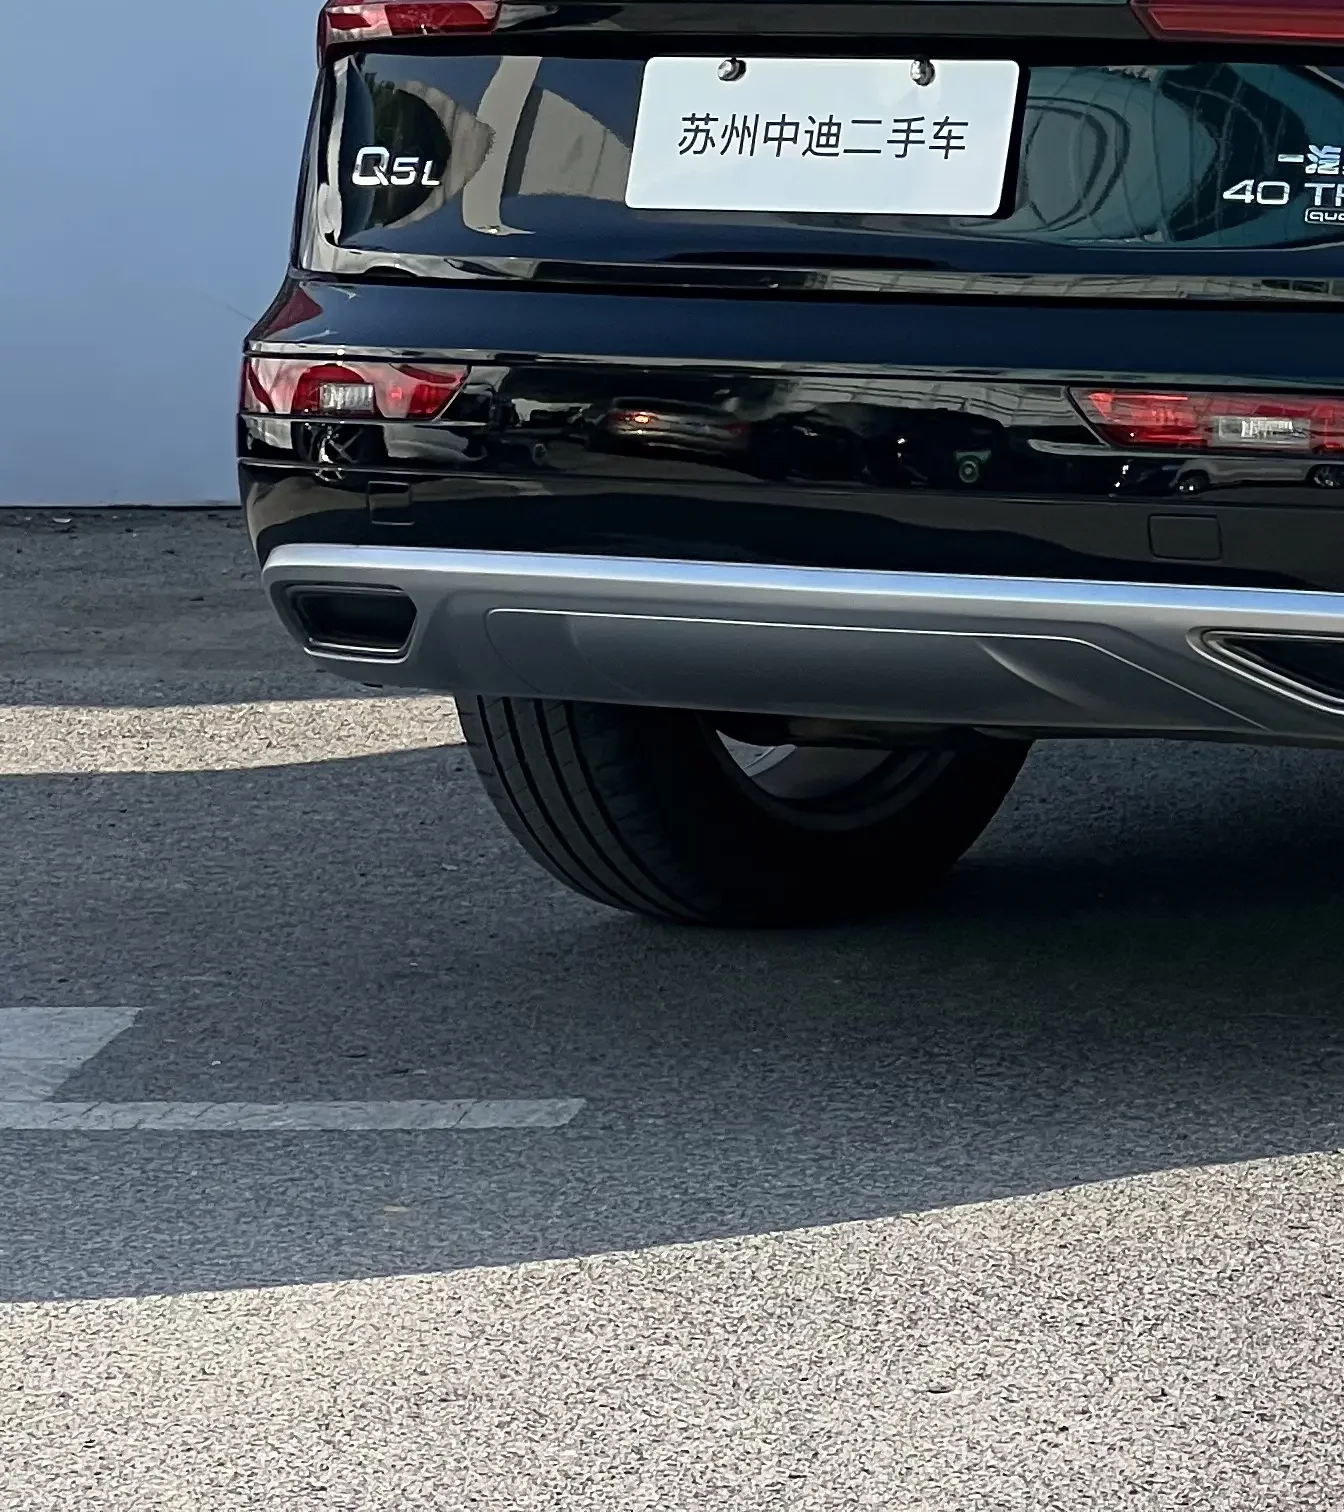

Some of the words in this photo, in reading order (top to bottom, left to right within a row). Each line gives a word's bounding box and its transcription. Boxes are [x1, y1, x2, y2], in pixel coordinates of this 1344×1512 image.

[678, 112, 970, 159] 苏州中迪二手车
[352, 146, 440, 186] Q5L
[1222, 179, 1291, 205] 40
